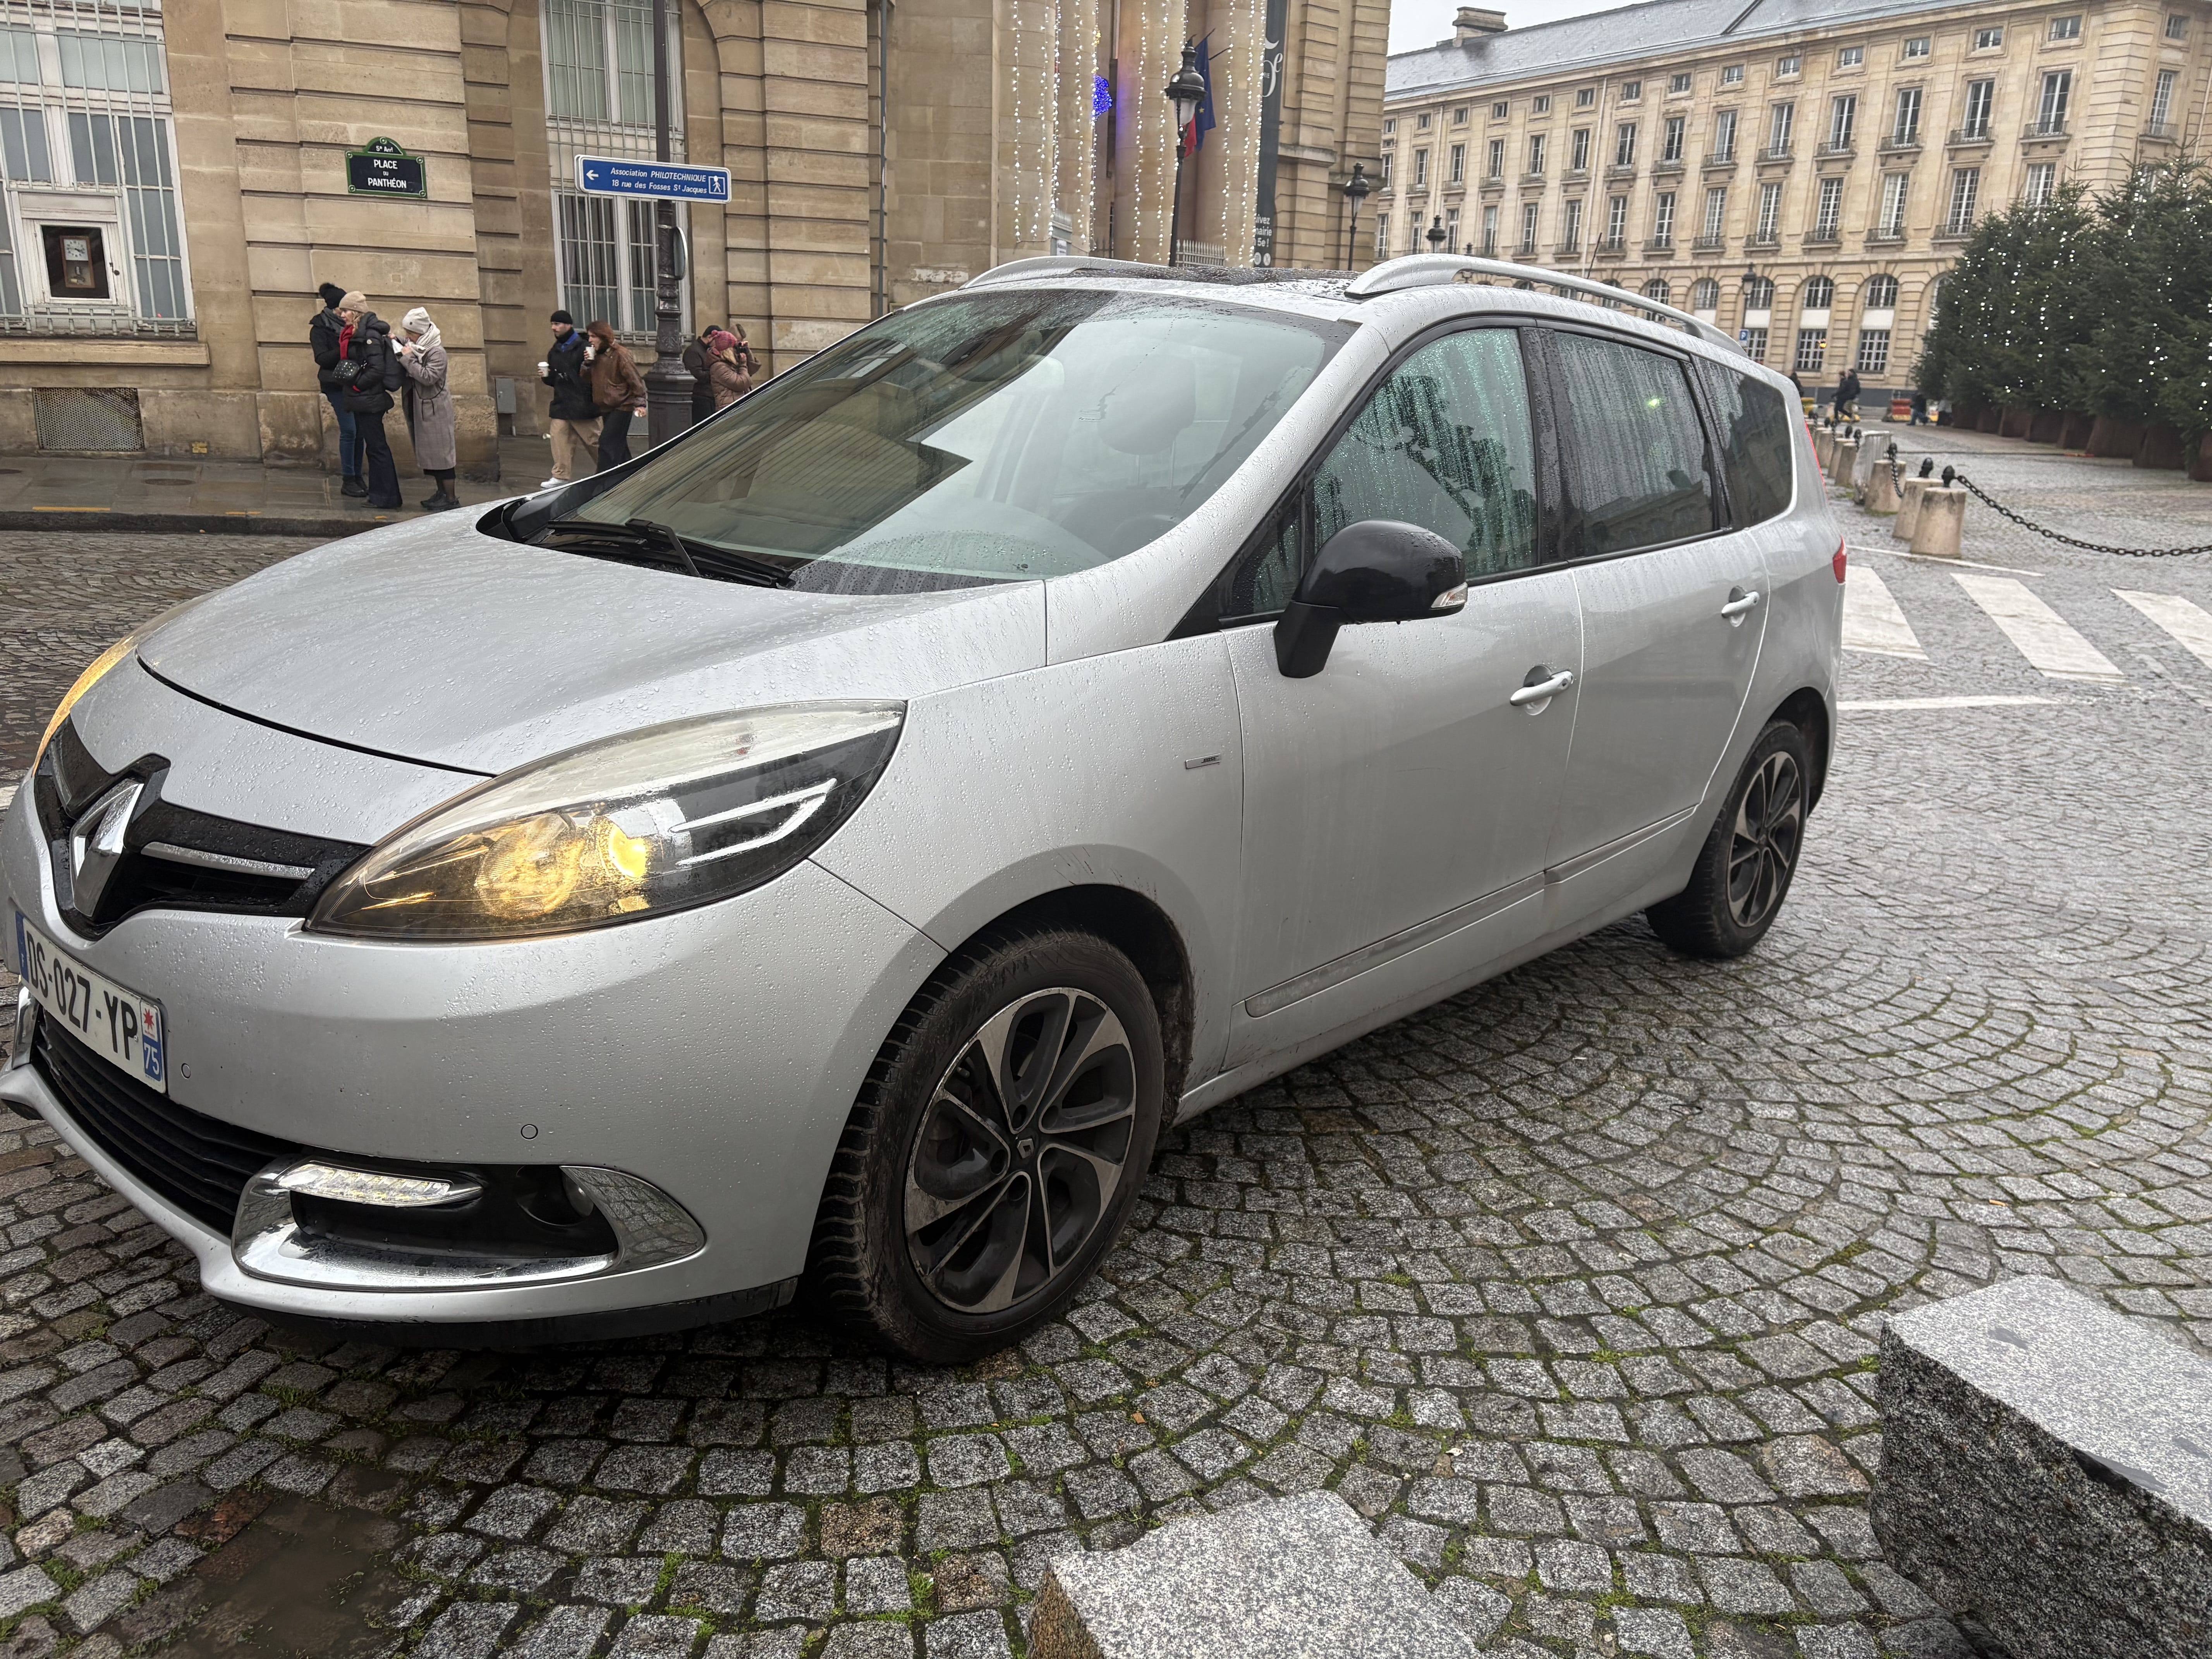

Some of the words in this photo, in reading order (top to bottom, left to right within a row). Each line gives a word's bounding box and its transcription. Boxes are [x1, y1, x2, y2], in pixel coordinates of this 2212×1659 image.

[373, 159, 398, 169] PLACE
[610, 167, 647, 177] Association
[651, 170, 706, 182] PHILOTECHNIQUE
[368, 177, 407, 189] PANTHÉON
[634, 181, 646, 189] des
[682, 185, 707, 194] Jacques
[1201, 756, 1219, 764] BOSE
[27, 930, 138, 1061] DS-027-YP
[144, 1042, 160, 1075] 75
